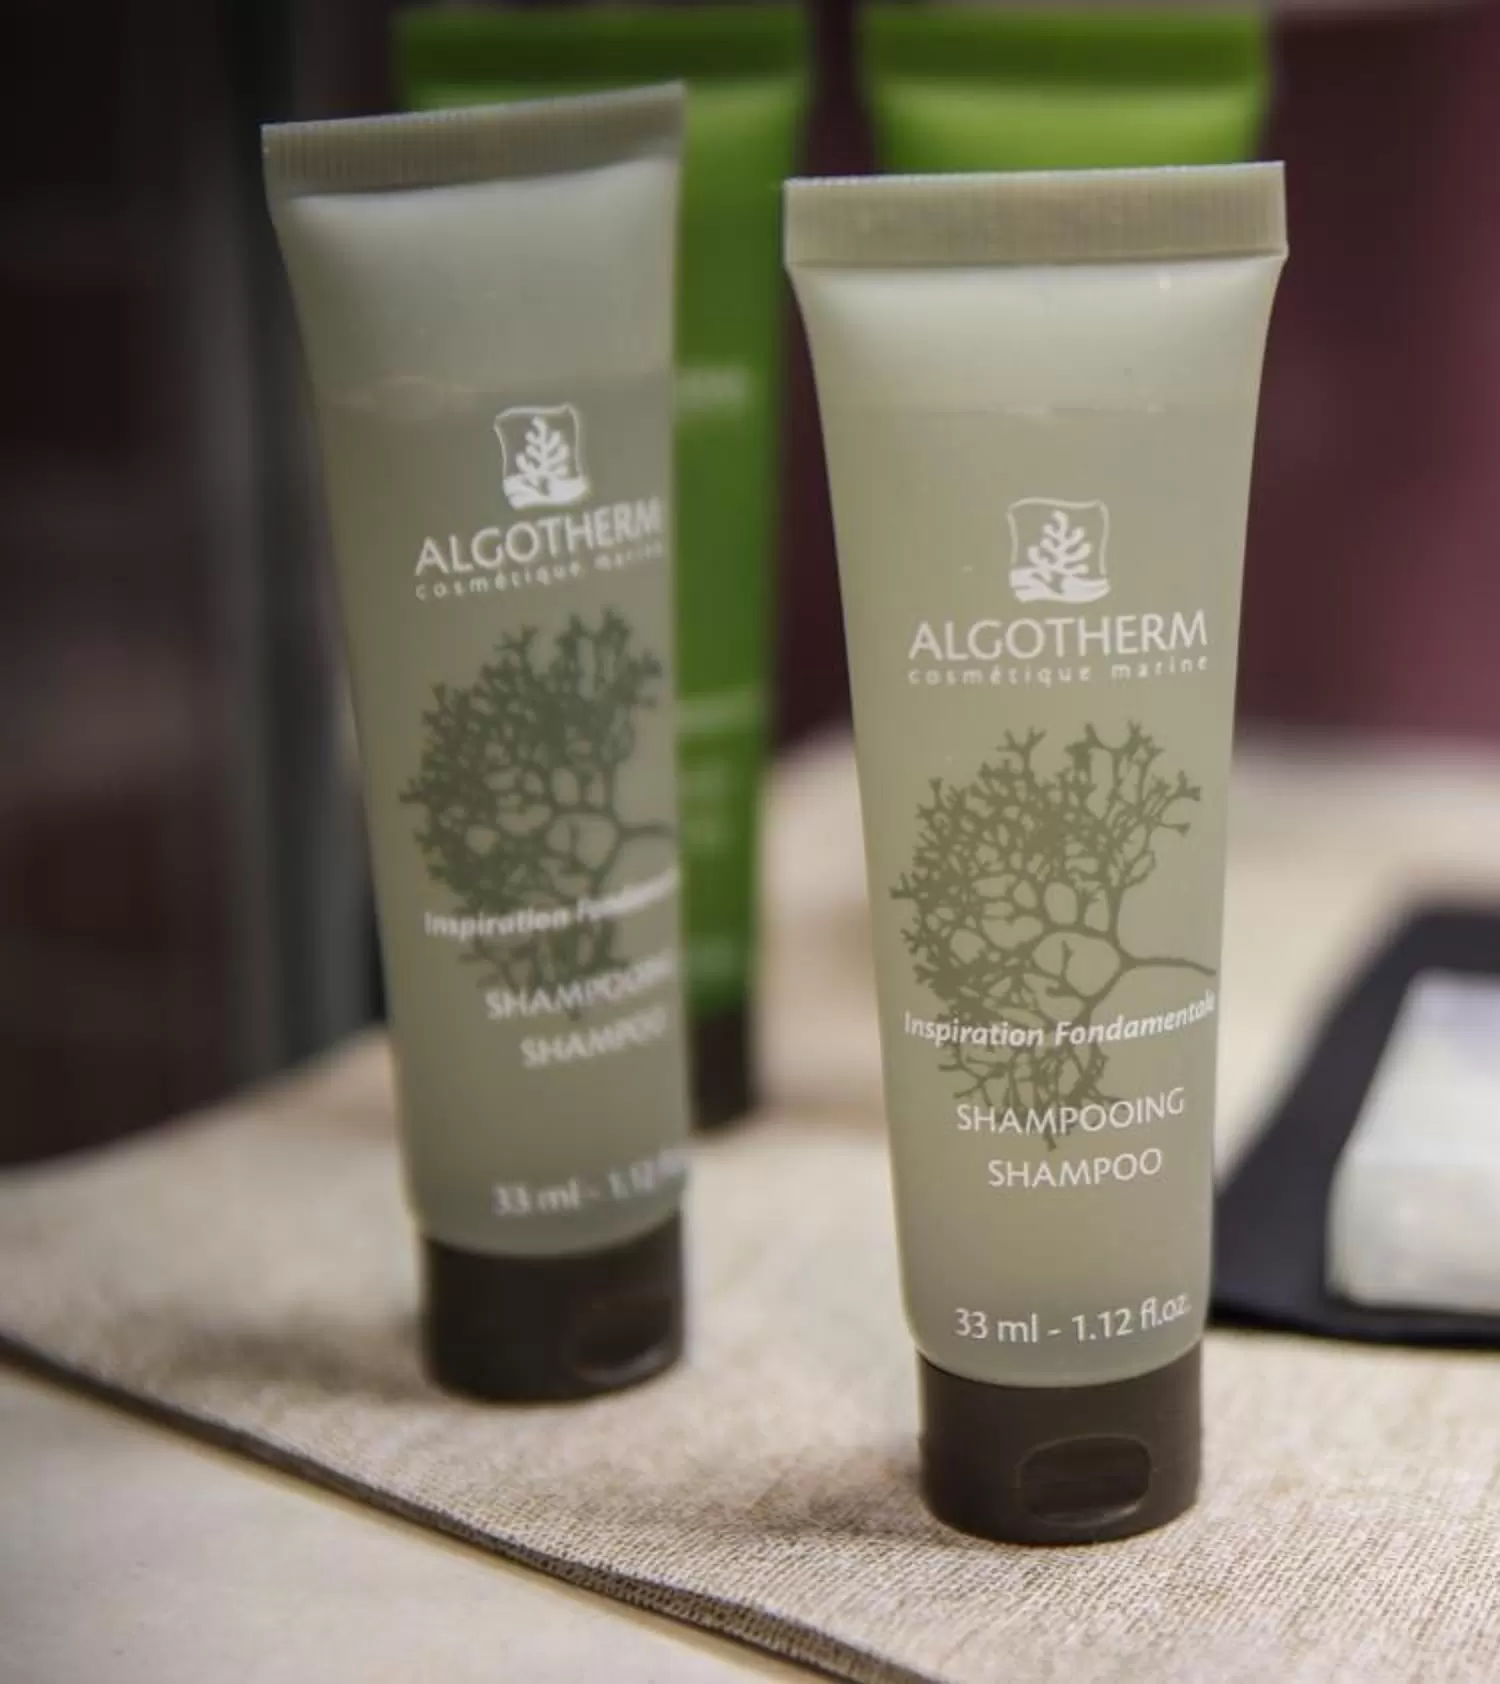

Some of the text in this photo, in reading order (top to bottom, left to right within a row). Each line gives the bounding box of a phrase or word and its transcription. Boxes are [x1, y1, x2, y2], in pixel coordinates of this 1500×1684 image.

[415, 495, 663, 577] ALGOTHERM
[908, 608, 1208, 661] ALGOTHERM
[908, 654, 1208, 689] cosmétique marine
[424, 908, 571, 942] Inspiration
[905, 1011, 1044, 1048] Inspiration
[957, 1088, 1185, 1135] SHAMPOOING
[988, 1148, 1162, 1189] SHAMPOO
[955, 1307, 989, 1339] 33
[997, 1312, 1038, 1343] ml
[1071, 1307, 1133, 1342] 1.12
